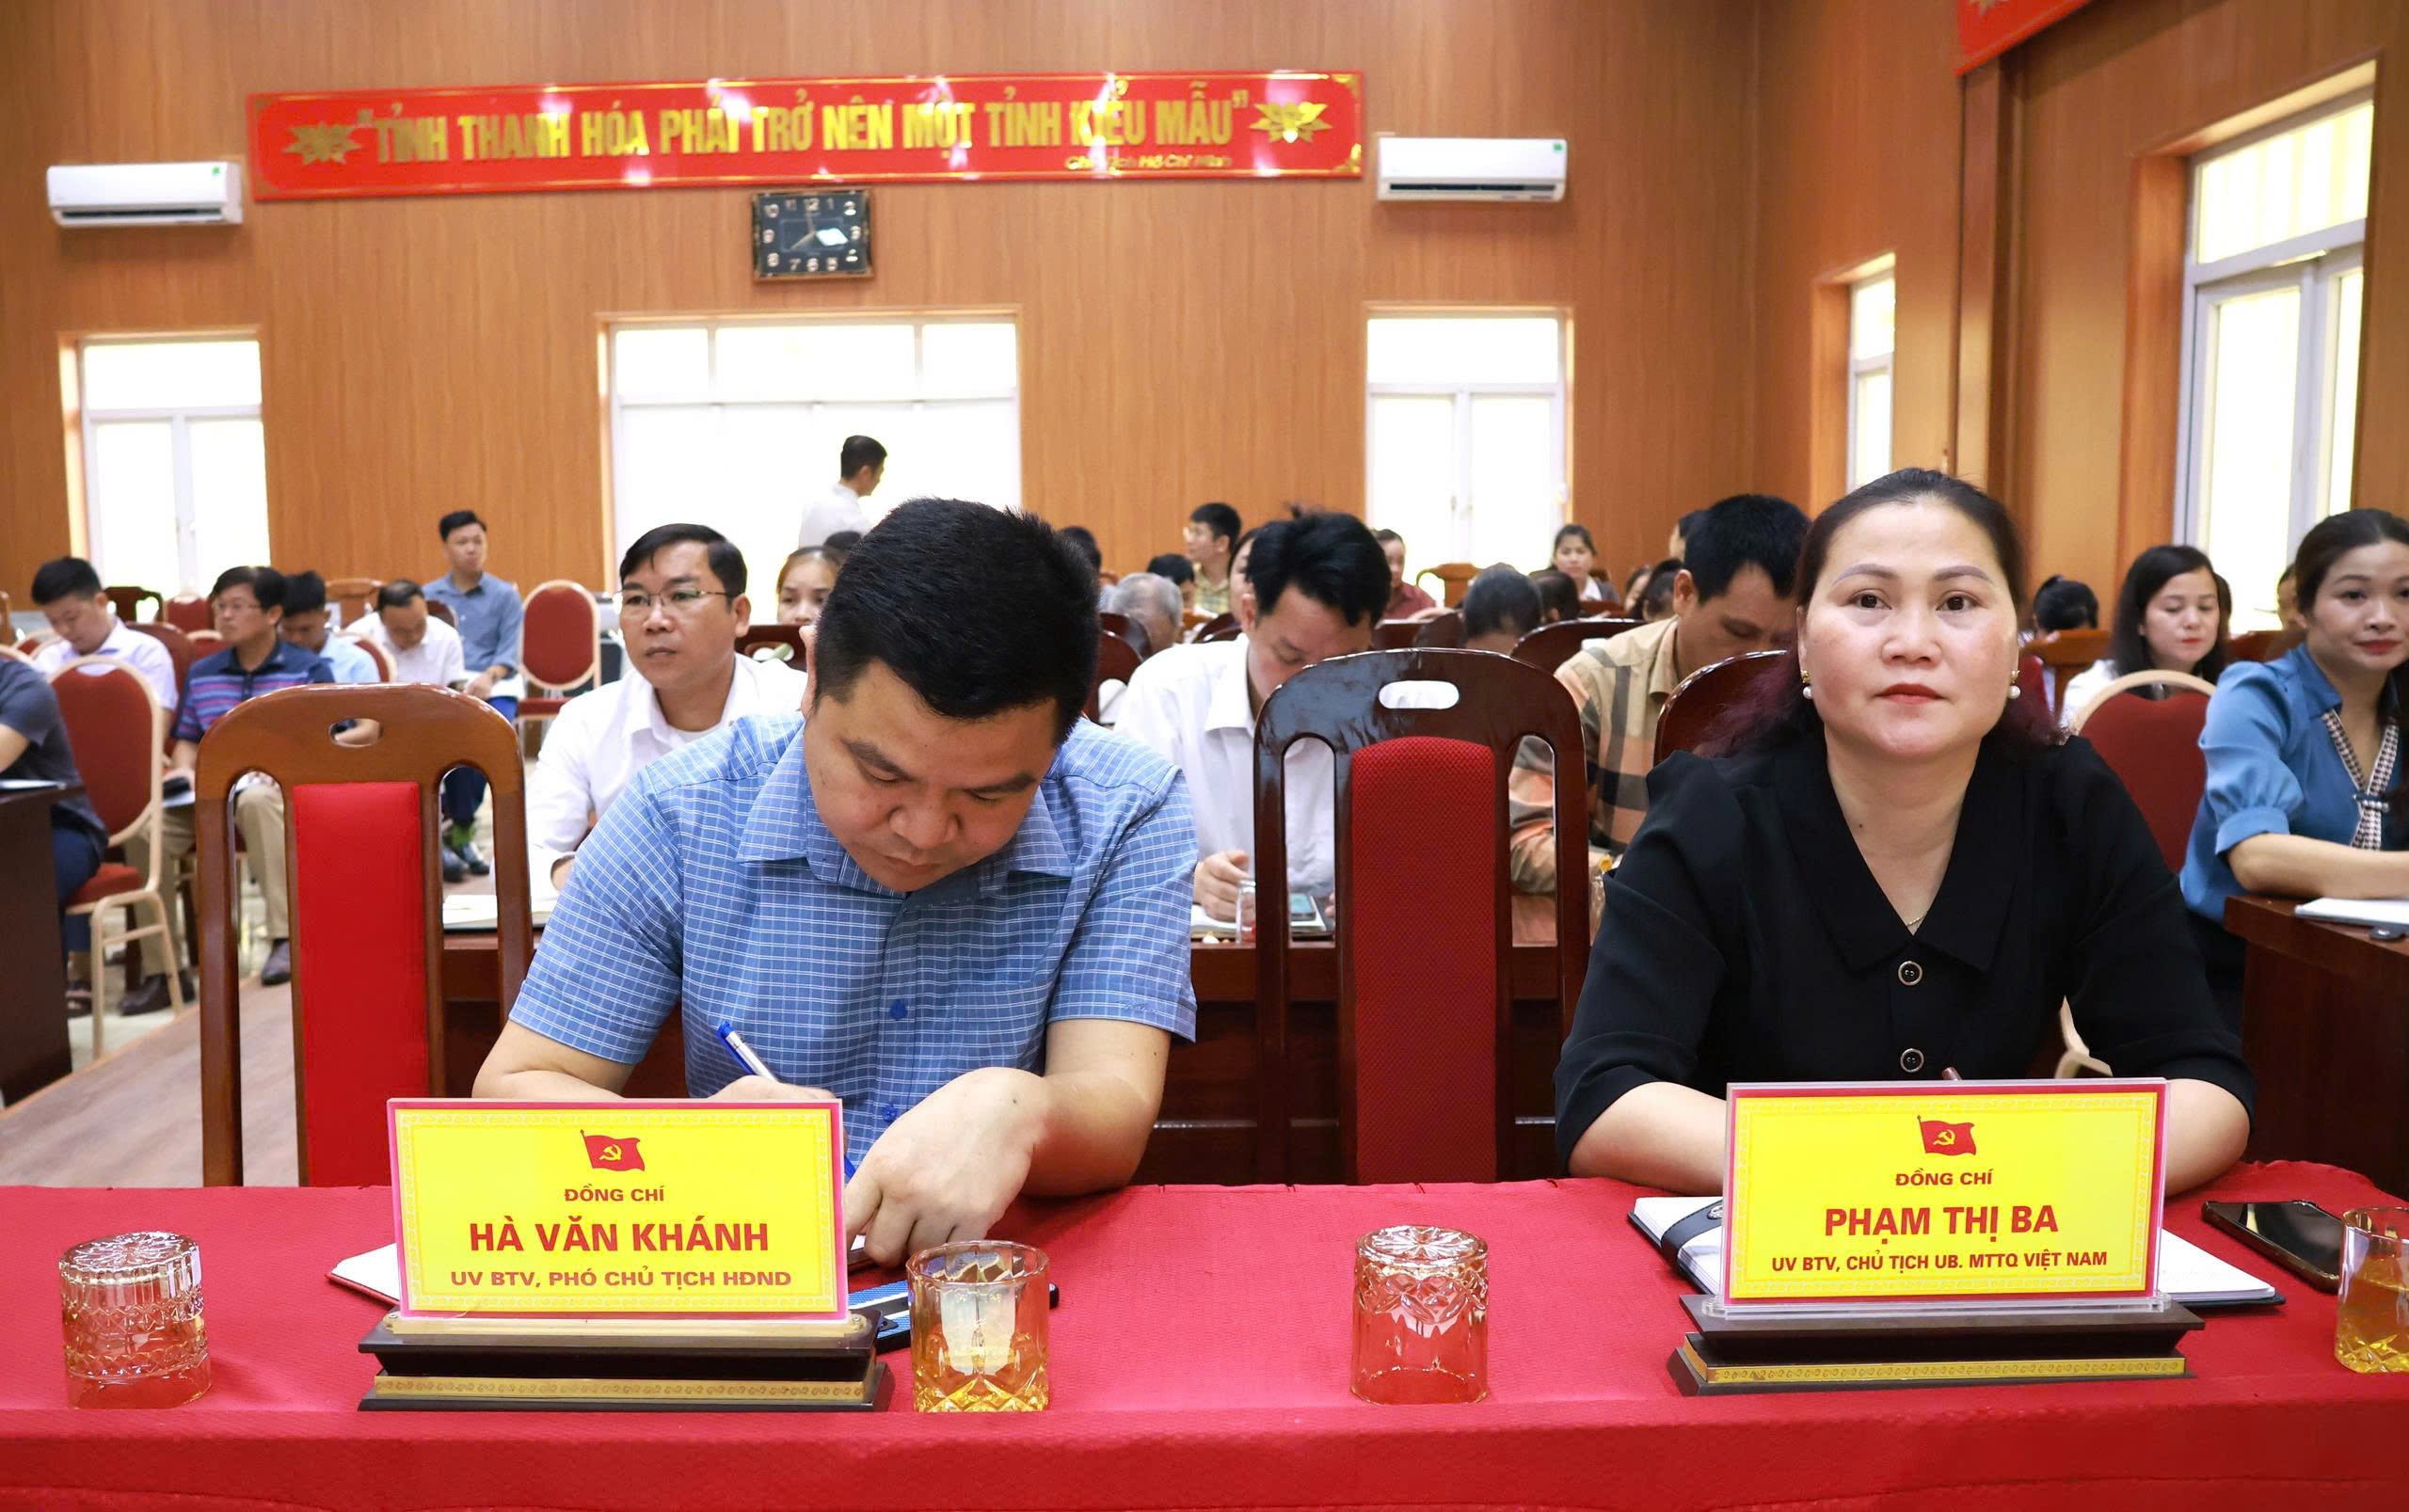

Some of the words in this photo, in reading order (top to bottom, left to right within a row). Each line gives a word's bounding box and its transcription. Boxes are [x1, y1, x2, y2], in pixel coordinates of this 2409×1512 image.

[458, 111, 570, 161] THANH
[581, 100, 649, 157] HÓA
[750, 88, 814, 152] TRỞ
[822, 95, 893, 151] NÊN
[984, 86, 1061, 148] TỈNH
[1895, 1168, 1954, 1186] ĐỒNG
[1960, 1169, 1993, 1186] CHÍ
[564, 1184, 624, 1202] ĐỒNG
[630, 1185, 664, 1202] CHÍ
[470, 1215, 524, 1251] HÀ
[534, 1215, 618, 1251] VĂN
[632, 1215, 769, 1251] KHÁNH
[1825, 1207, 1931, 1245] PHẠM
[1943, 1205, 1999, 1243] THỊ
[2011, 1204, 2059, 1233] BA
[1772, 1257, 1797, 1271] UV
[1802, 1256, 1841, 1272] BTV,
[1846, 1249, 1884, 1270] CHỦ
[1889, 1254, 1929, 1273] TỊCH
[1935, 1254, 1963, 1269] UB.
[1969, 1252, 2018, 1268] MTTQ
[2023, 1249, 2062, 1271] VIỆT
[2066, 1251, 2108, 1266] NAM
[451, 1271, 483, 1286] UV
[491, 1271, 542, 1288] BTV,
[549, 1268, 597, 1286] PHÓ
[604, 1265, 654, 1286] CHỦ
[662, 1271, 715, 1290] TỊCH
[723, 1271, 791, 1286] HĐND
